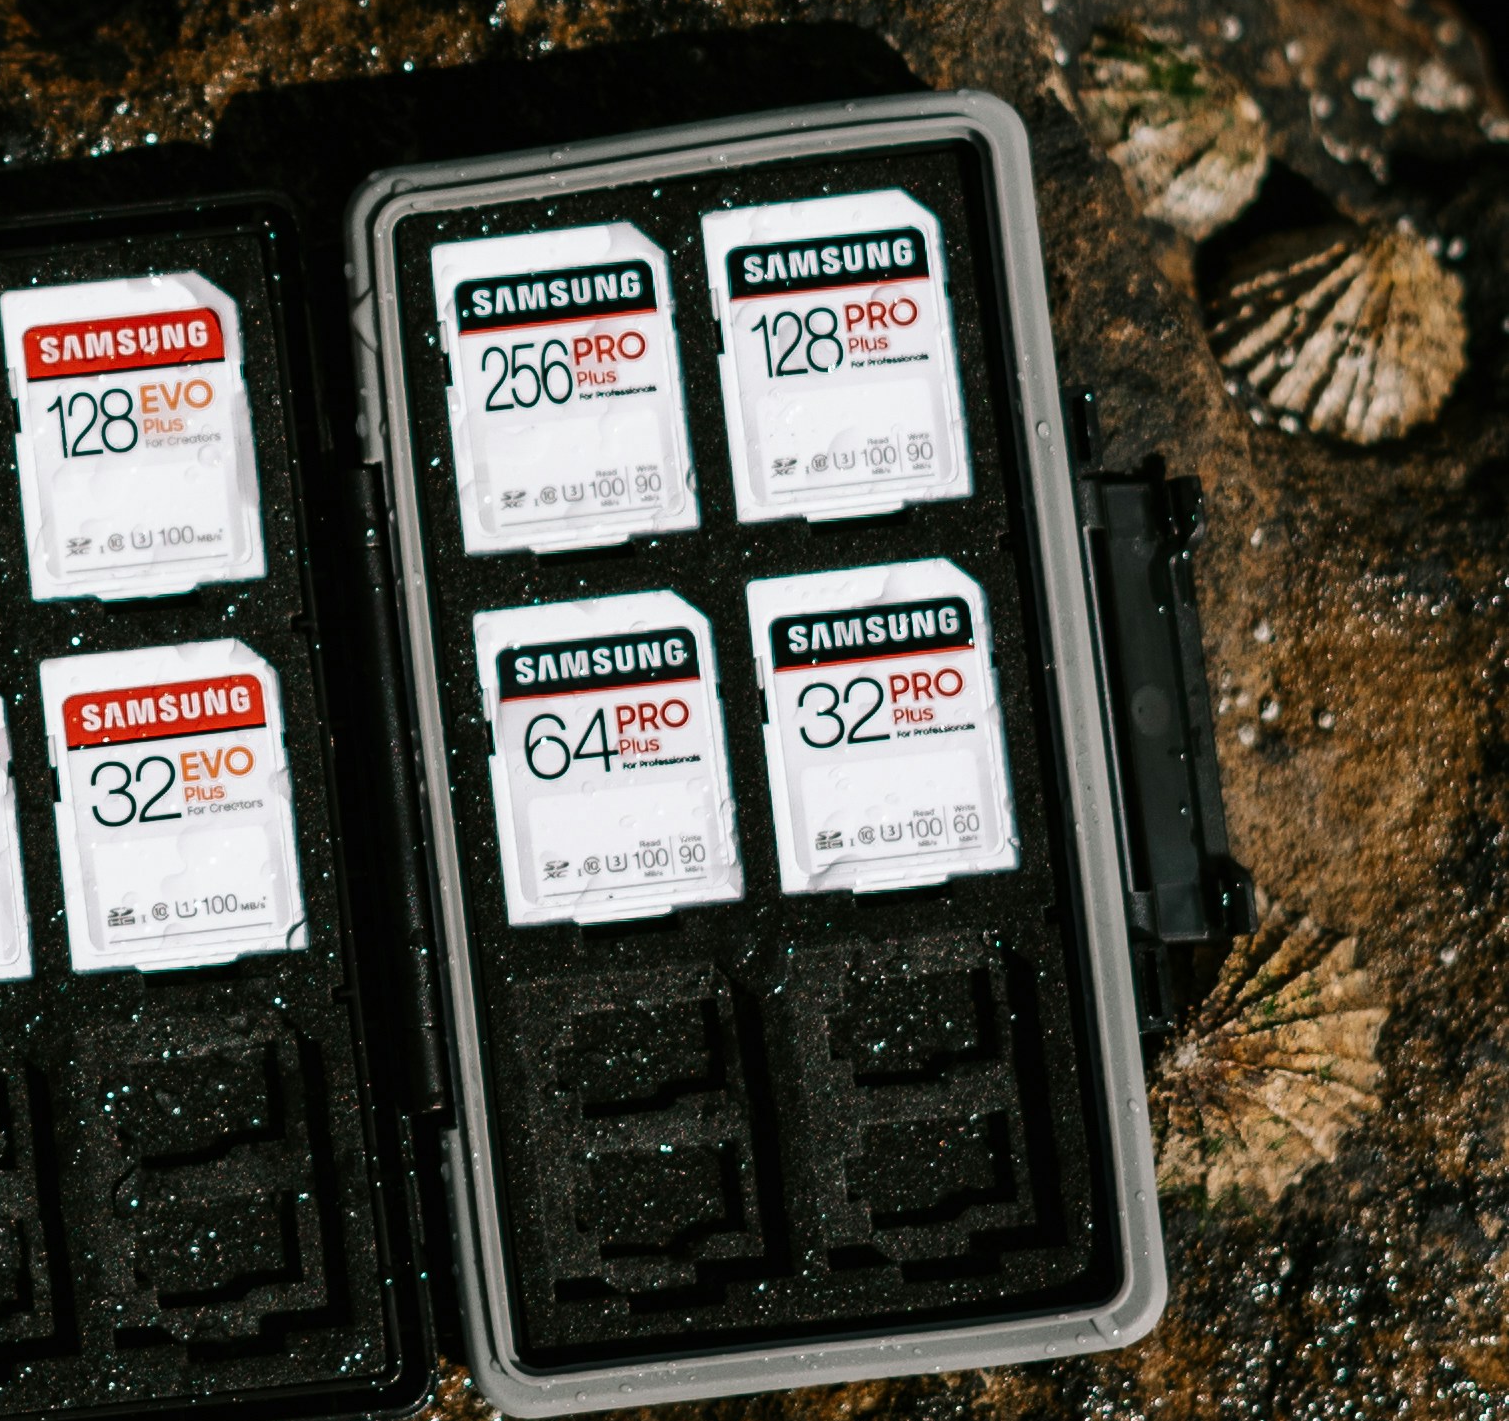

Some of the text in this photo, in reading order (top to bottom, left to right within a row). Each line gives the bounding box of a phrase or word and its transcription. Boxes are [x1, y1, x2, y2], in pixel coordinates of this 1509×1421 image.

[744, 239, 913, 283] SAMSUNG
[472, 271, 641, 317] SAMSUNG
[40, 320, 209, 364] SAMSUNG
[751, 297, 918, 378] 128 PRO
[849, 336, 888, 353] Plus
[482, 332, 646, 411] 256 PRO
[851, 360, 865, 369] For
[576, 368, 617, 387] Plus
[579, 393, 594, 401] For
[47, 379, 213, 458] 128 EVO
[143, 417, 184, 434] Plus
[145, 437, 164, 449] For
[907, 441, 933, 461] 90
[861, 445, 896, 467] 100
[589, 477, 625, 498] 100
[635, 473, 661, 493] 90
[159, 525, 194, 546] 100
[789, 606, 959, 653] SAMSUNG
[515, 639, 685, 684] SAMSUNG
[81, 686, 250, 732] SAMSUNG
[797, 668, 963, 749] 32 PRO
[894, 707, 933, 724] Plus
[524, 698, 689, 780] 64 PRO
[897, 730, 911, 738] For
[619, 738, 660, 755] Plus
[622, 761, 637, 770] For
[90, 746, 253, 827] 32 EVO
[185, 784, 225, 802] Plus
[187, 804, 207, 816] For
[907, 817, 942, 838] 100
[953, 813, 979, 834] 60
[633, 848, 669, 869] 100
[679, 844, 705, 864] 90
[202, 894, 237, 914] 100
